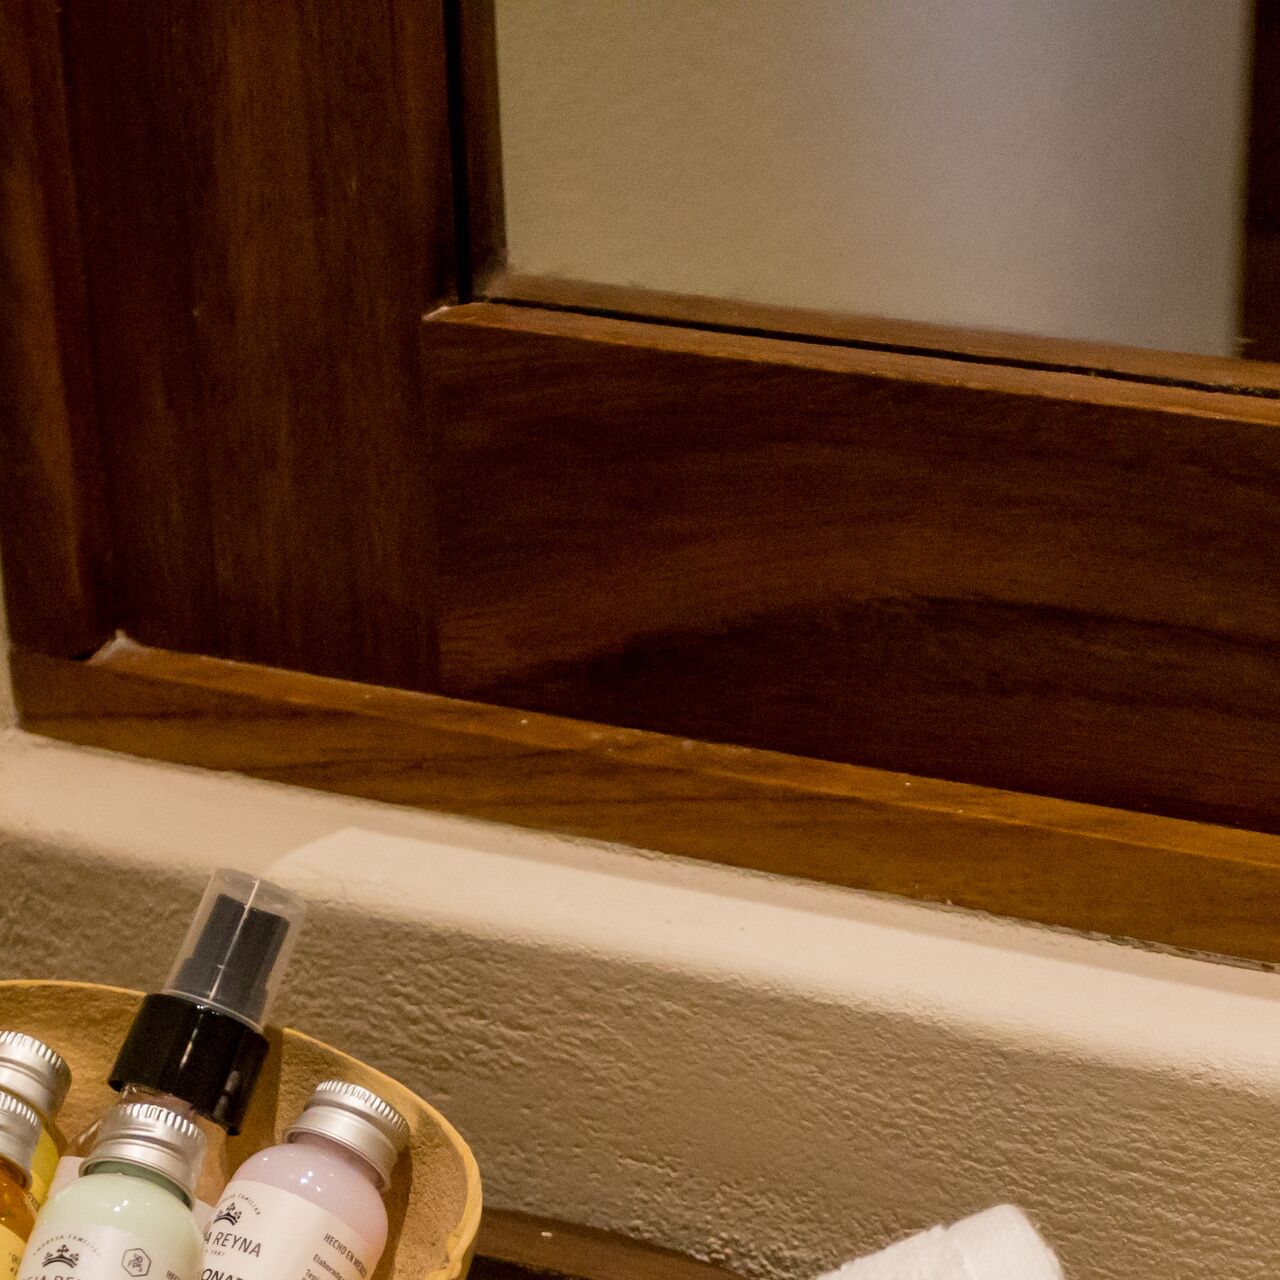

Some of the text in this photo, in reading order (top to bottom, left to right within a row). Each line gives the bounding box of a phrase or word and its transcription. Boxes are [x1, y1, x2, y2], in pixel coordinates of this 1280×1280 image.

[212, 1232, 262, 1258] REYNA
[323, 1233, 347, 1255] HECHO
[312, 1253, 342, 1280] Elaborado
